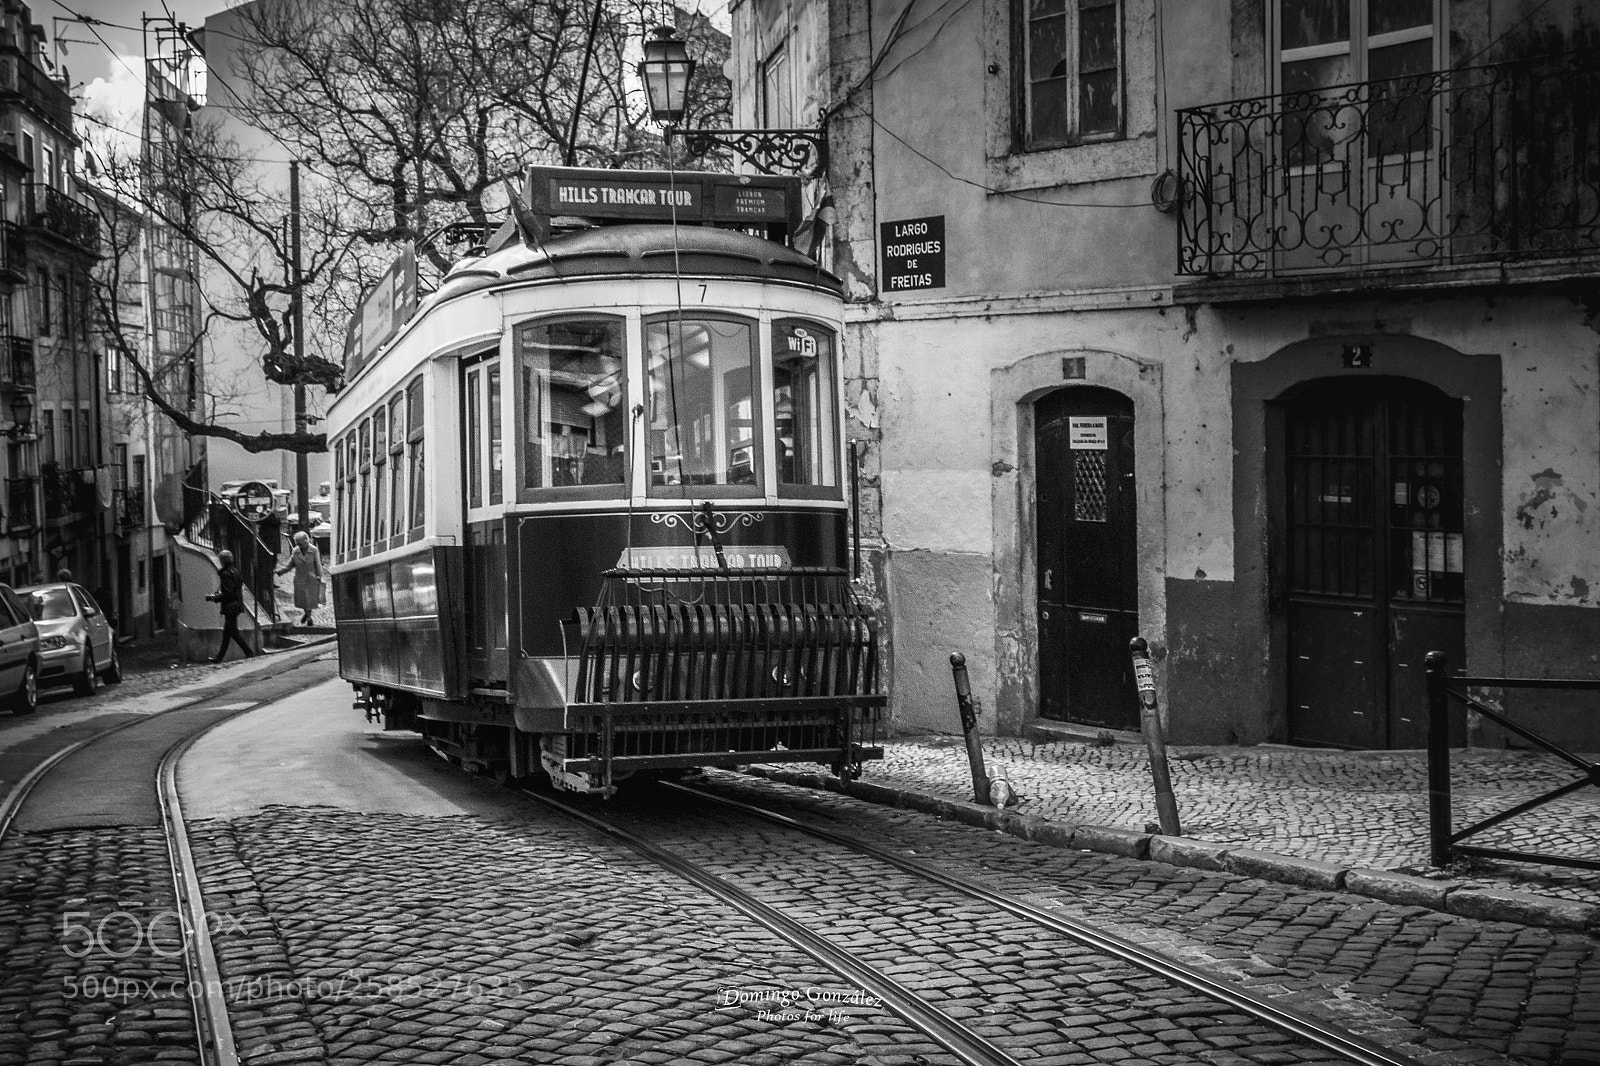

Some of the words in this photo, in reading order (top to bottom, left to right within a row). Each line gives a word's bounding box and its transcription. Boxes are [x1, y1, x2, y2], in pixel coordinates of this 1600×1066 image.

[559, 186, 599, 204] HILLS
[659, 189, 693, 206] TOUR
[895, 222, 928, 238] LARGO
[886, 240, 941, 258] RODRIGUES
[907, 259, 918, 269] DE
[891, 273, 932, 289] FREITAS
[698, 284, 707, 303] 7
[1352, 346, 1361, 366] 2
[748, 553, 783, 568] TOUR
